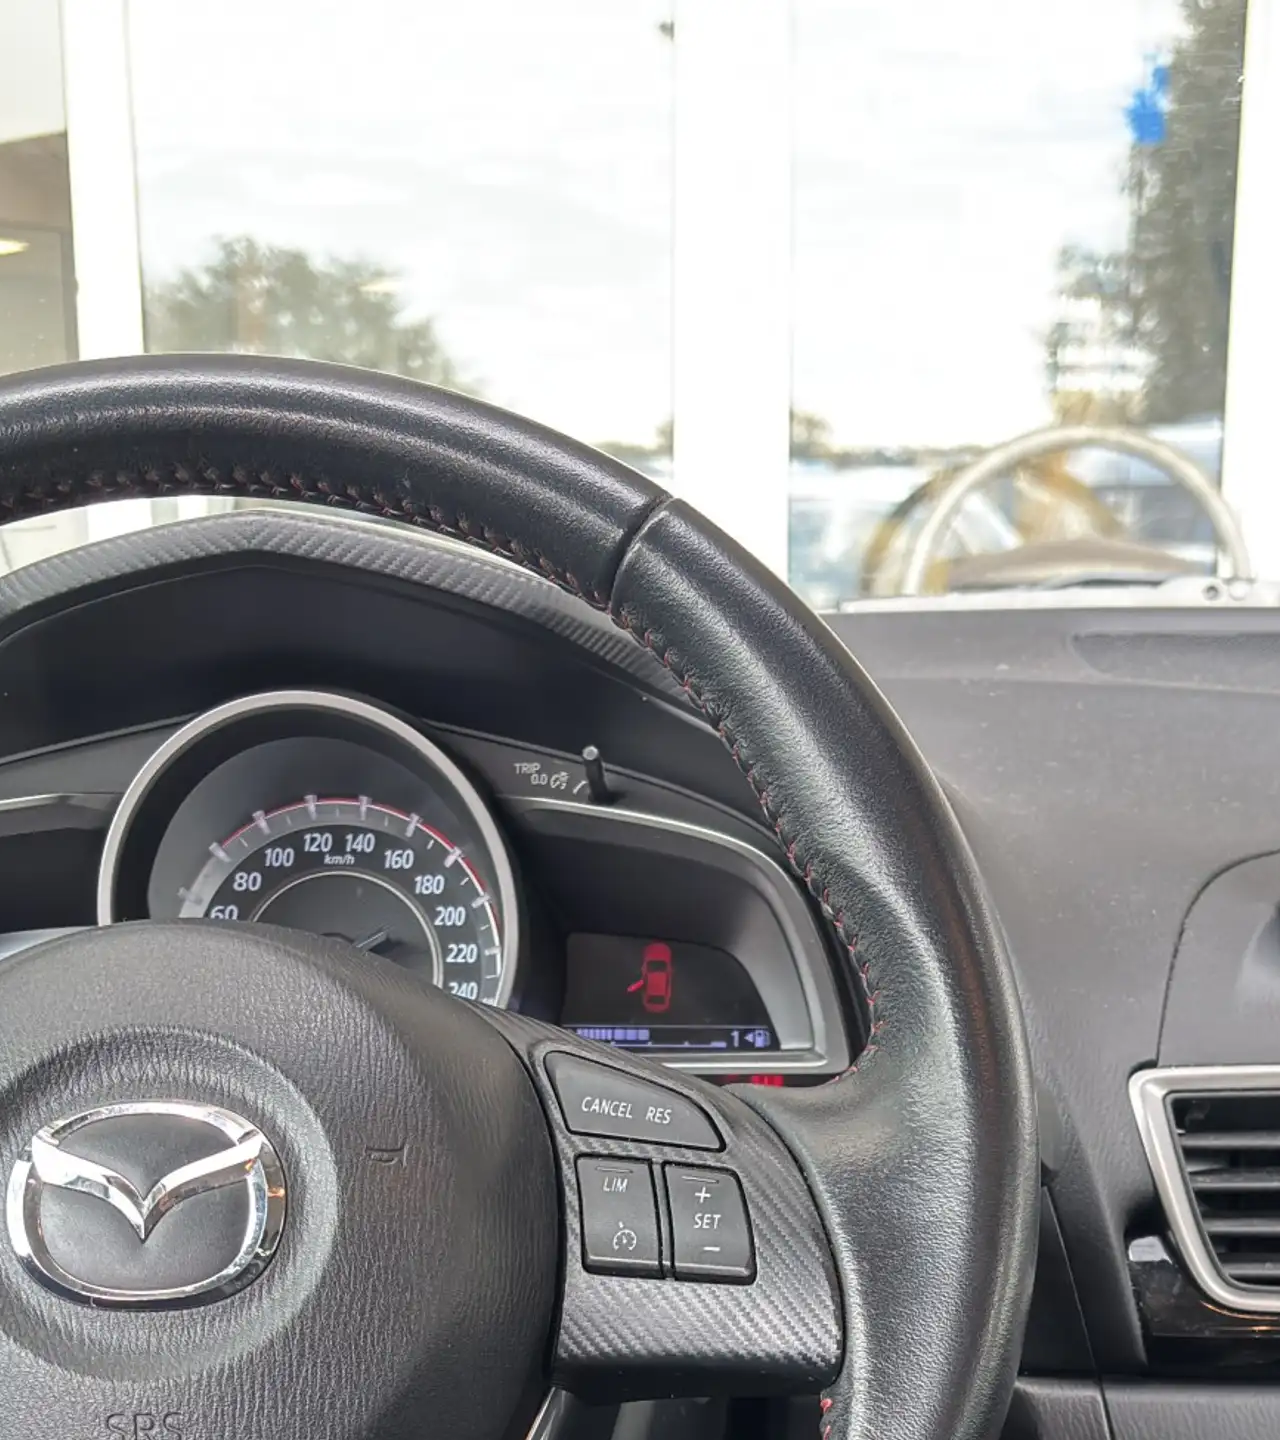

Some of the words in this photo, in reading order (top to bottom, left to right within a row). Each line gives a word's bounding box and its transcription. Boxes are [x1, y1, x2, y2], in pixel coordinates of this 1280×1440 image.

[514, 763, 540, 775] TRIP
[303, 833, 332, 852] 120
[344, 834, 375, 853] 140
[264, 848, 294, 867] 100
[324, 853, 355, 866] km/h
[383, 850, 414, 869] 160
[233, 872, 262, 892] 80
[414, 876, 445, 894] 180
[209, 905, 238, 921] 60
[434, 907, 466, 926] 200
[446, 945, 478, 963] 220
[449, 982, 478, 999] 240
[581, 1097, 633, 1118] CANCEL
[645, 1107, 672, 1124] RES
[603, 1177, 628, 1192] LIM
[693, 1214, 721, 1229] SET
